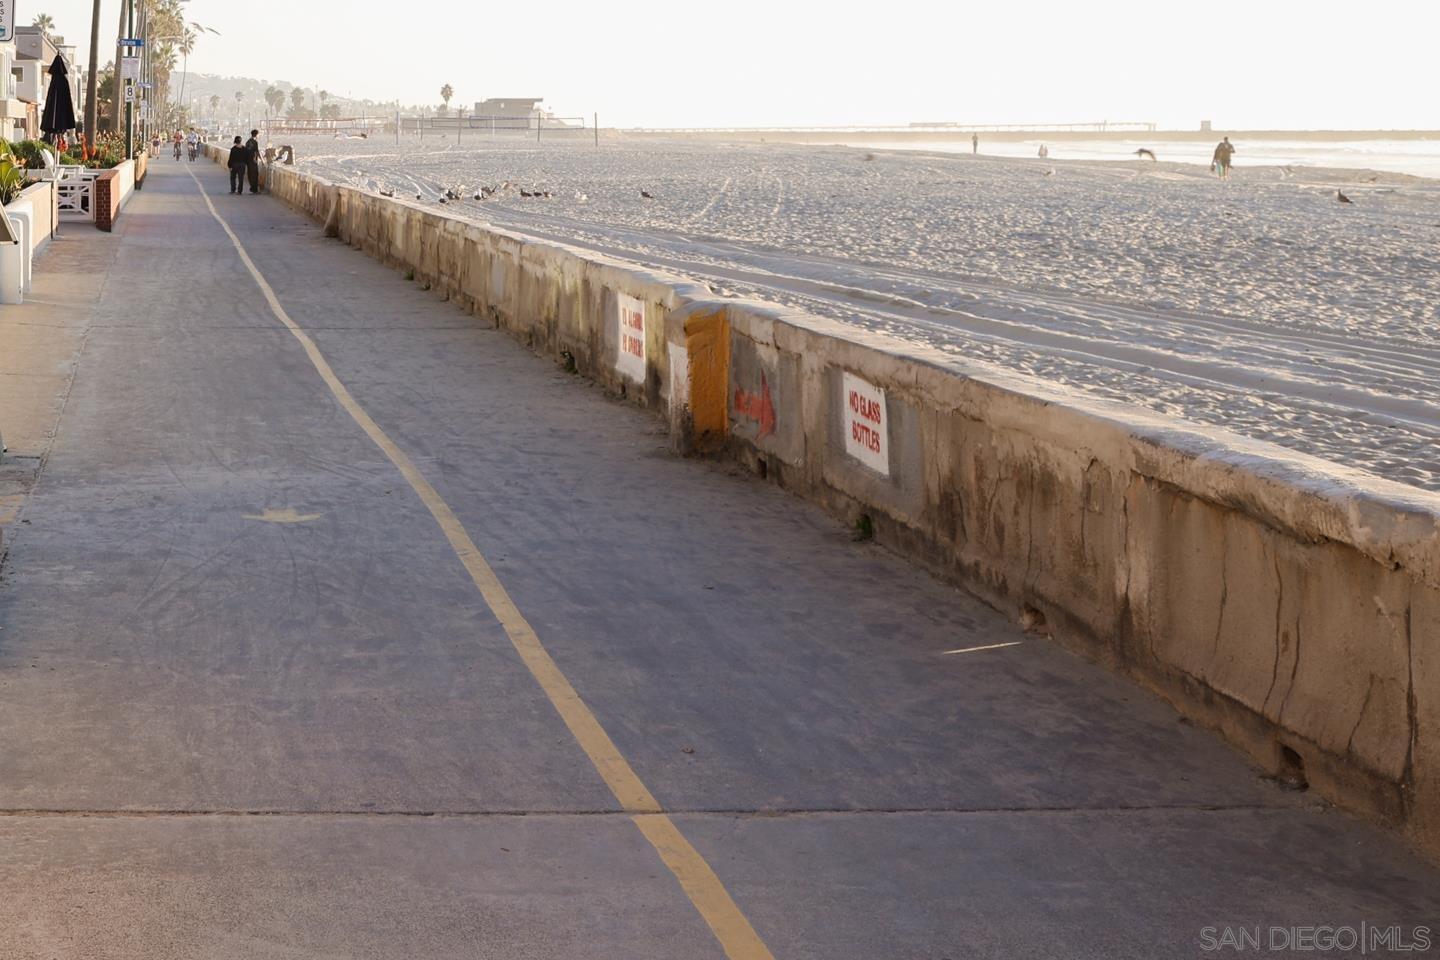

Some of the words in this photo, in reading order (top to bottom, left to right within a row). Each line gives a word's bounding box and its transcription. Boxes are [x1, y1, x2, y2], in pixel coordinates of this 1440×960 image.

[127, 87, 133, 96] 8
[849, 390, 858, 413] NO
[860, 395, 881, 424] GLASS
[852, 420, 880, 453] BOTTLES
